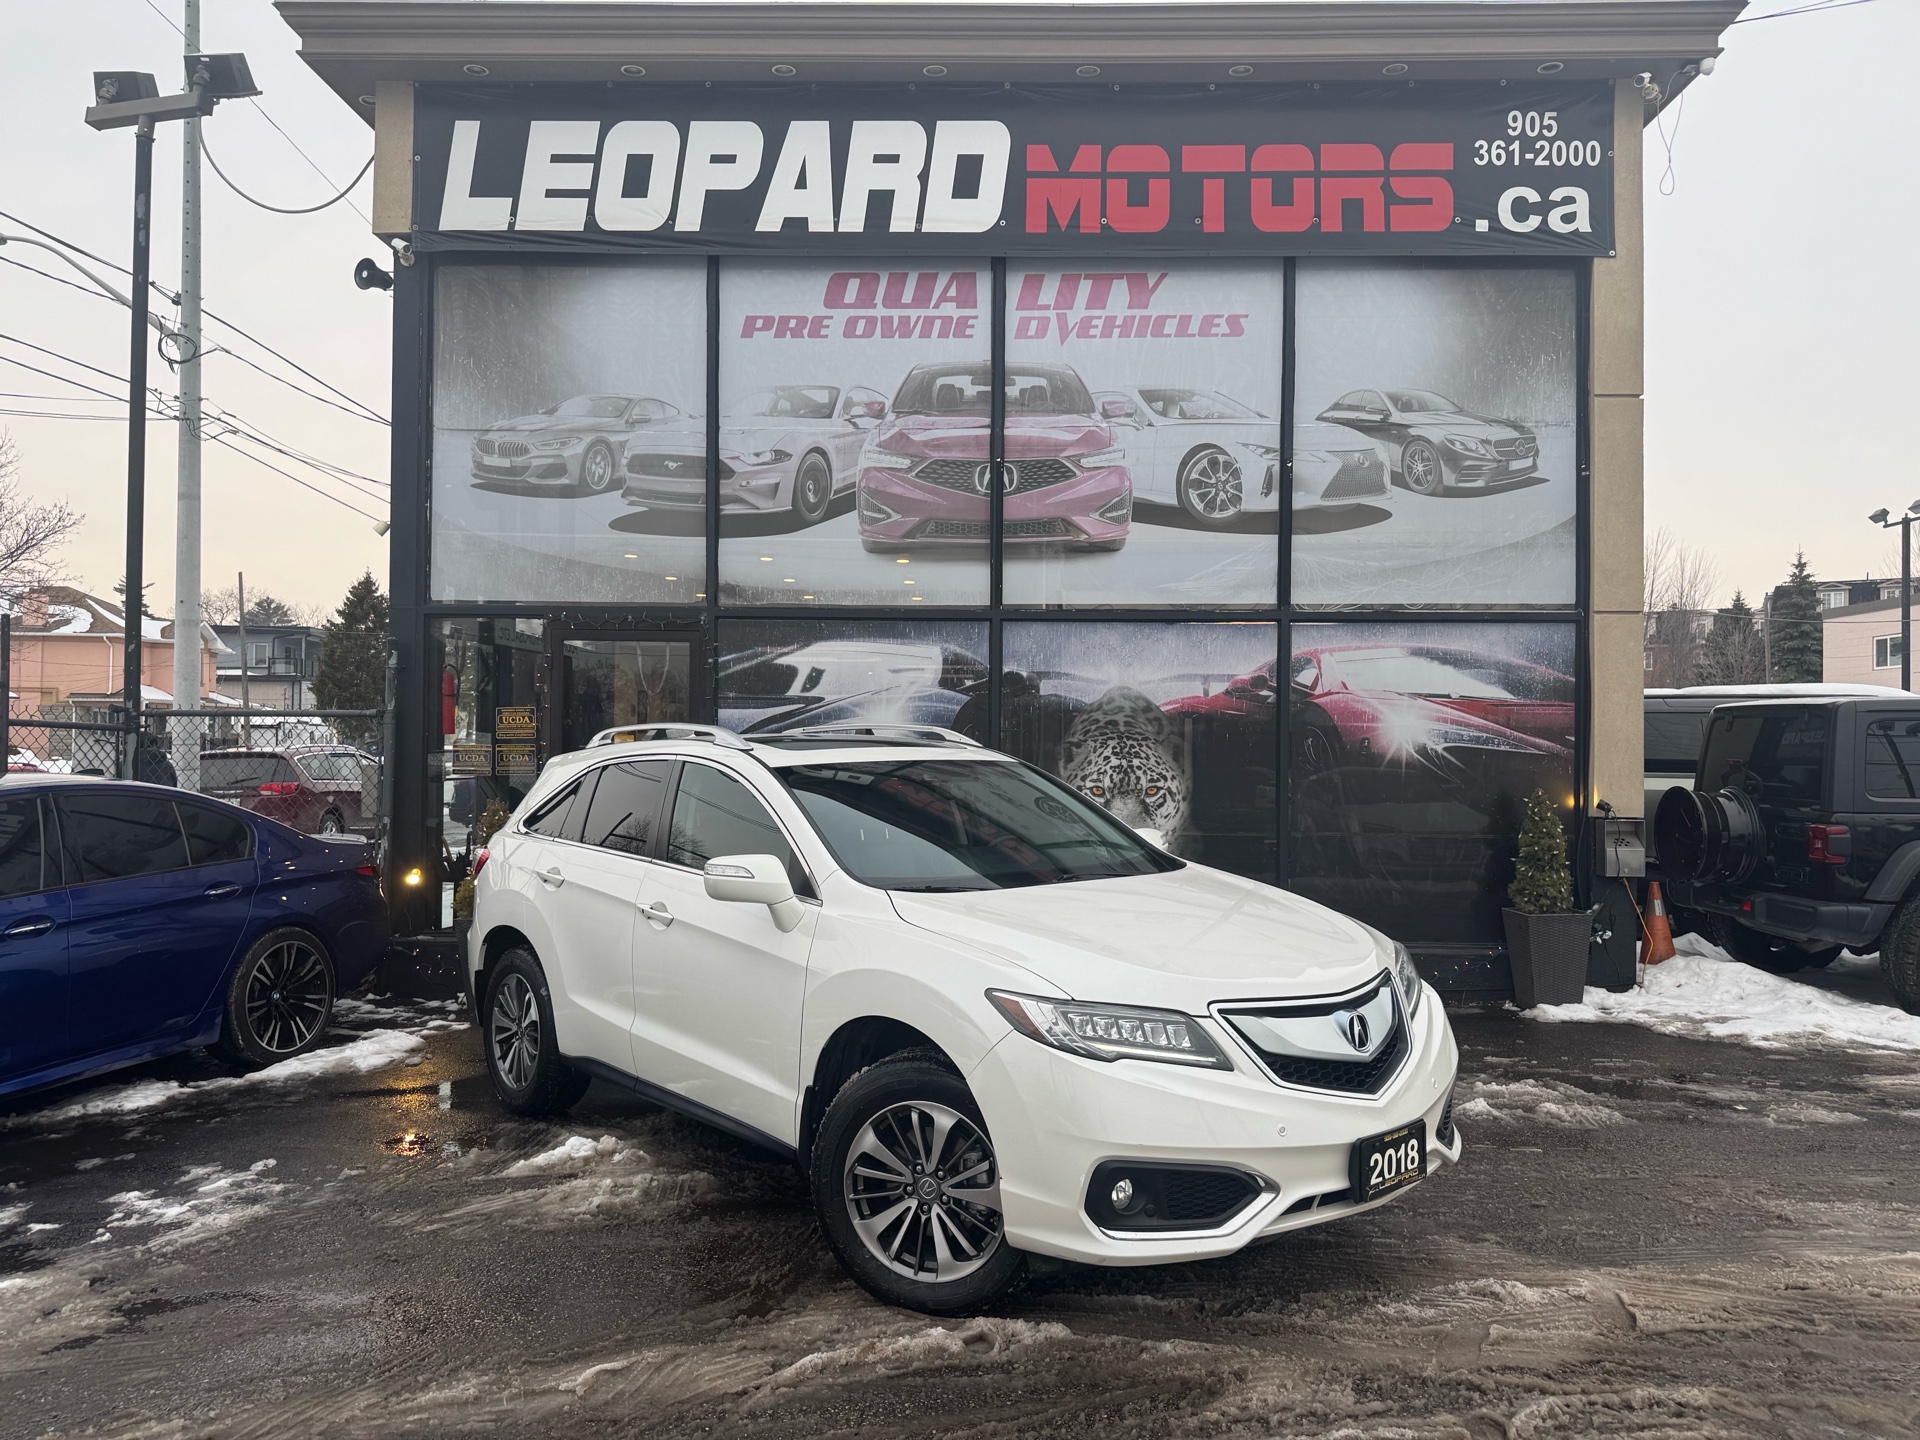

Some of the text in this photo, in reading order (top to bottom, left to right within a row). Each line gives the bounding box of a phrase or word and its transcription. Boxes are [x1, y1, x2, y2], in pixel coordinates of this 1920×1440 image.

[1507, 110, 1558, 137] 905
[1473, 140, 1601, 166] 361-2000
[438, 120, 1454, 233] LEOPARD MOTORS
[1475, 186, 1592, 233] .ca
[823, 272, 977, 309] QUA
[1015, 272, 1169, 311] LITY
[740, 315, 978, 338] PRE OWNE
[502, 716, 530, 724] UCDA
[459, 754, 486, 762] UCDA
[502, 754, 530, 762] UCDA
[1370, 1138, 1419, 1185] 2018
[1379, 1168, 1419, 1190] LEOPARD
